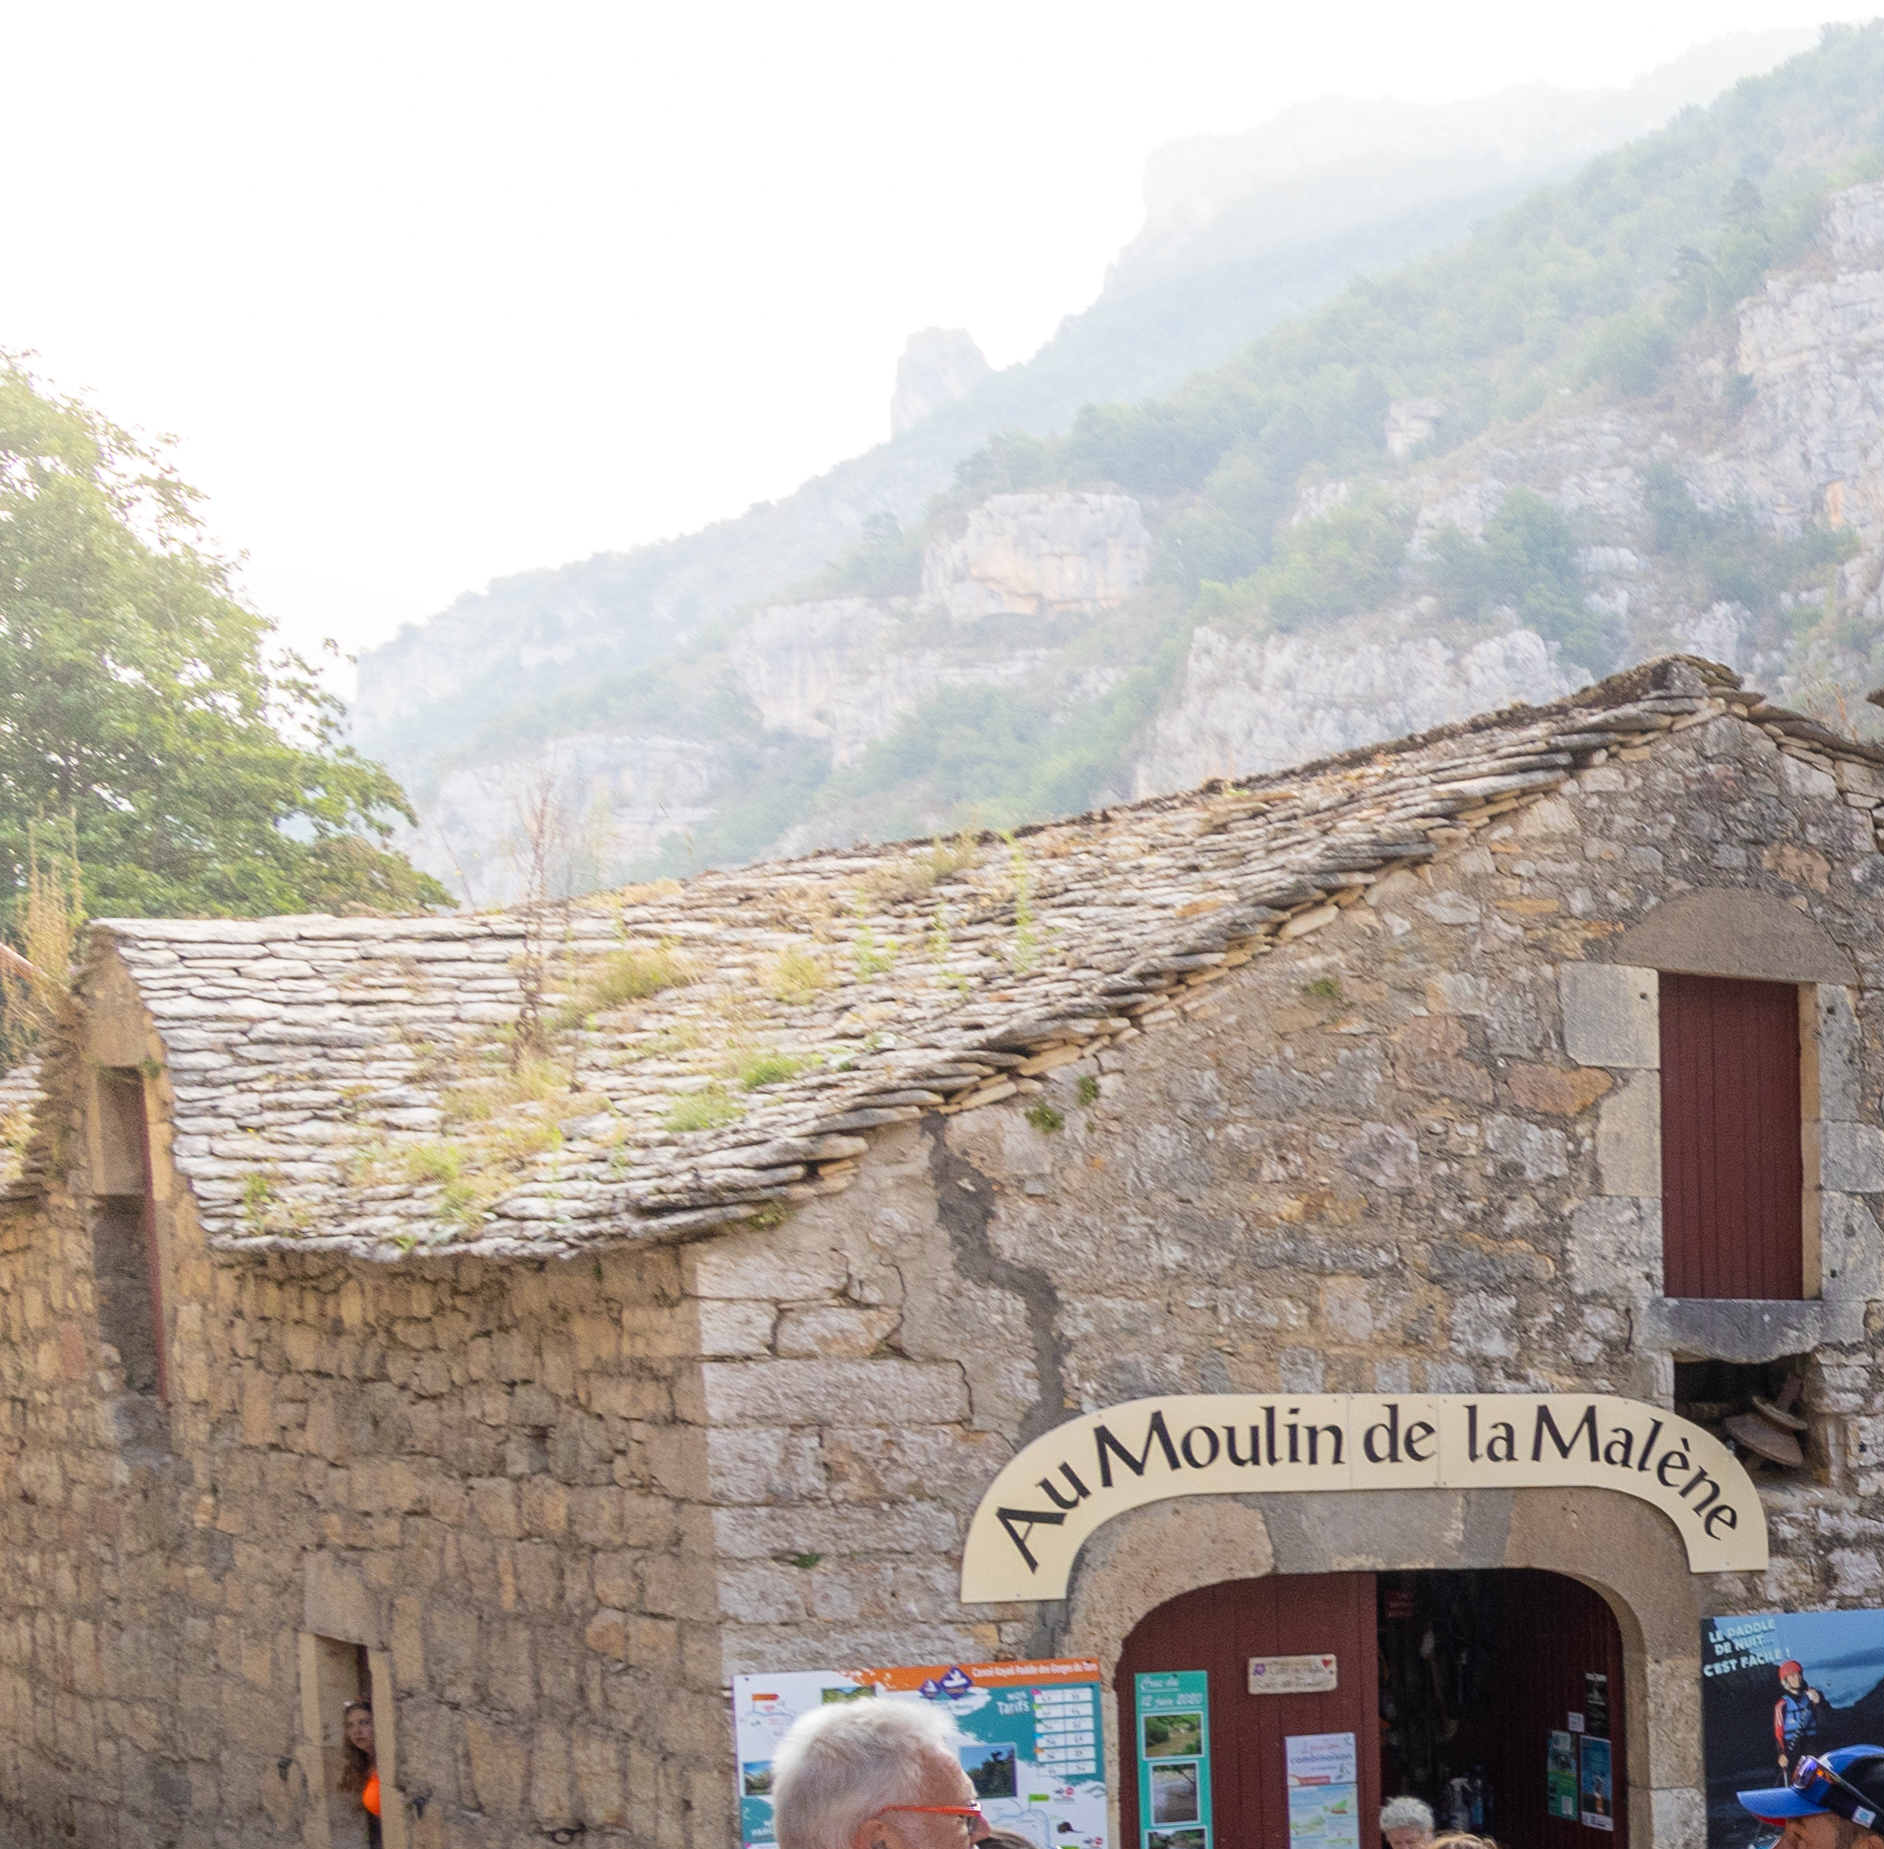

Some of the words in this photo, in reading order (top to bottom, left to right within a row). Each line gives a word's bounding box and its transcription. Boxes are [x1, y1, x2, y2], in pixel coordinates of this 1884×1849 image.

[995, 1464, 1092, 1574] Au
[1094, 1405, 1344, 1490] Moulin
[1362, 1401, 1437, 1464] de
[1466, 1402, 1518, 1462] la
[1529, 1402, 1741, 1542] Malène
[1708, 1630, 1725, 1644] LE
[1726, 1619, 1776, 1640] PADDLE
[1714, 1641, 1732, 1656] DE
[1740, 1649, 1782, 1669] FACILE
[996, 1701, 1030, 1716] Tarifs
